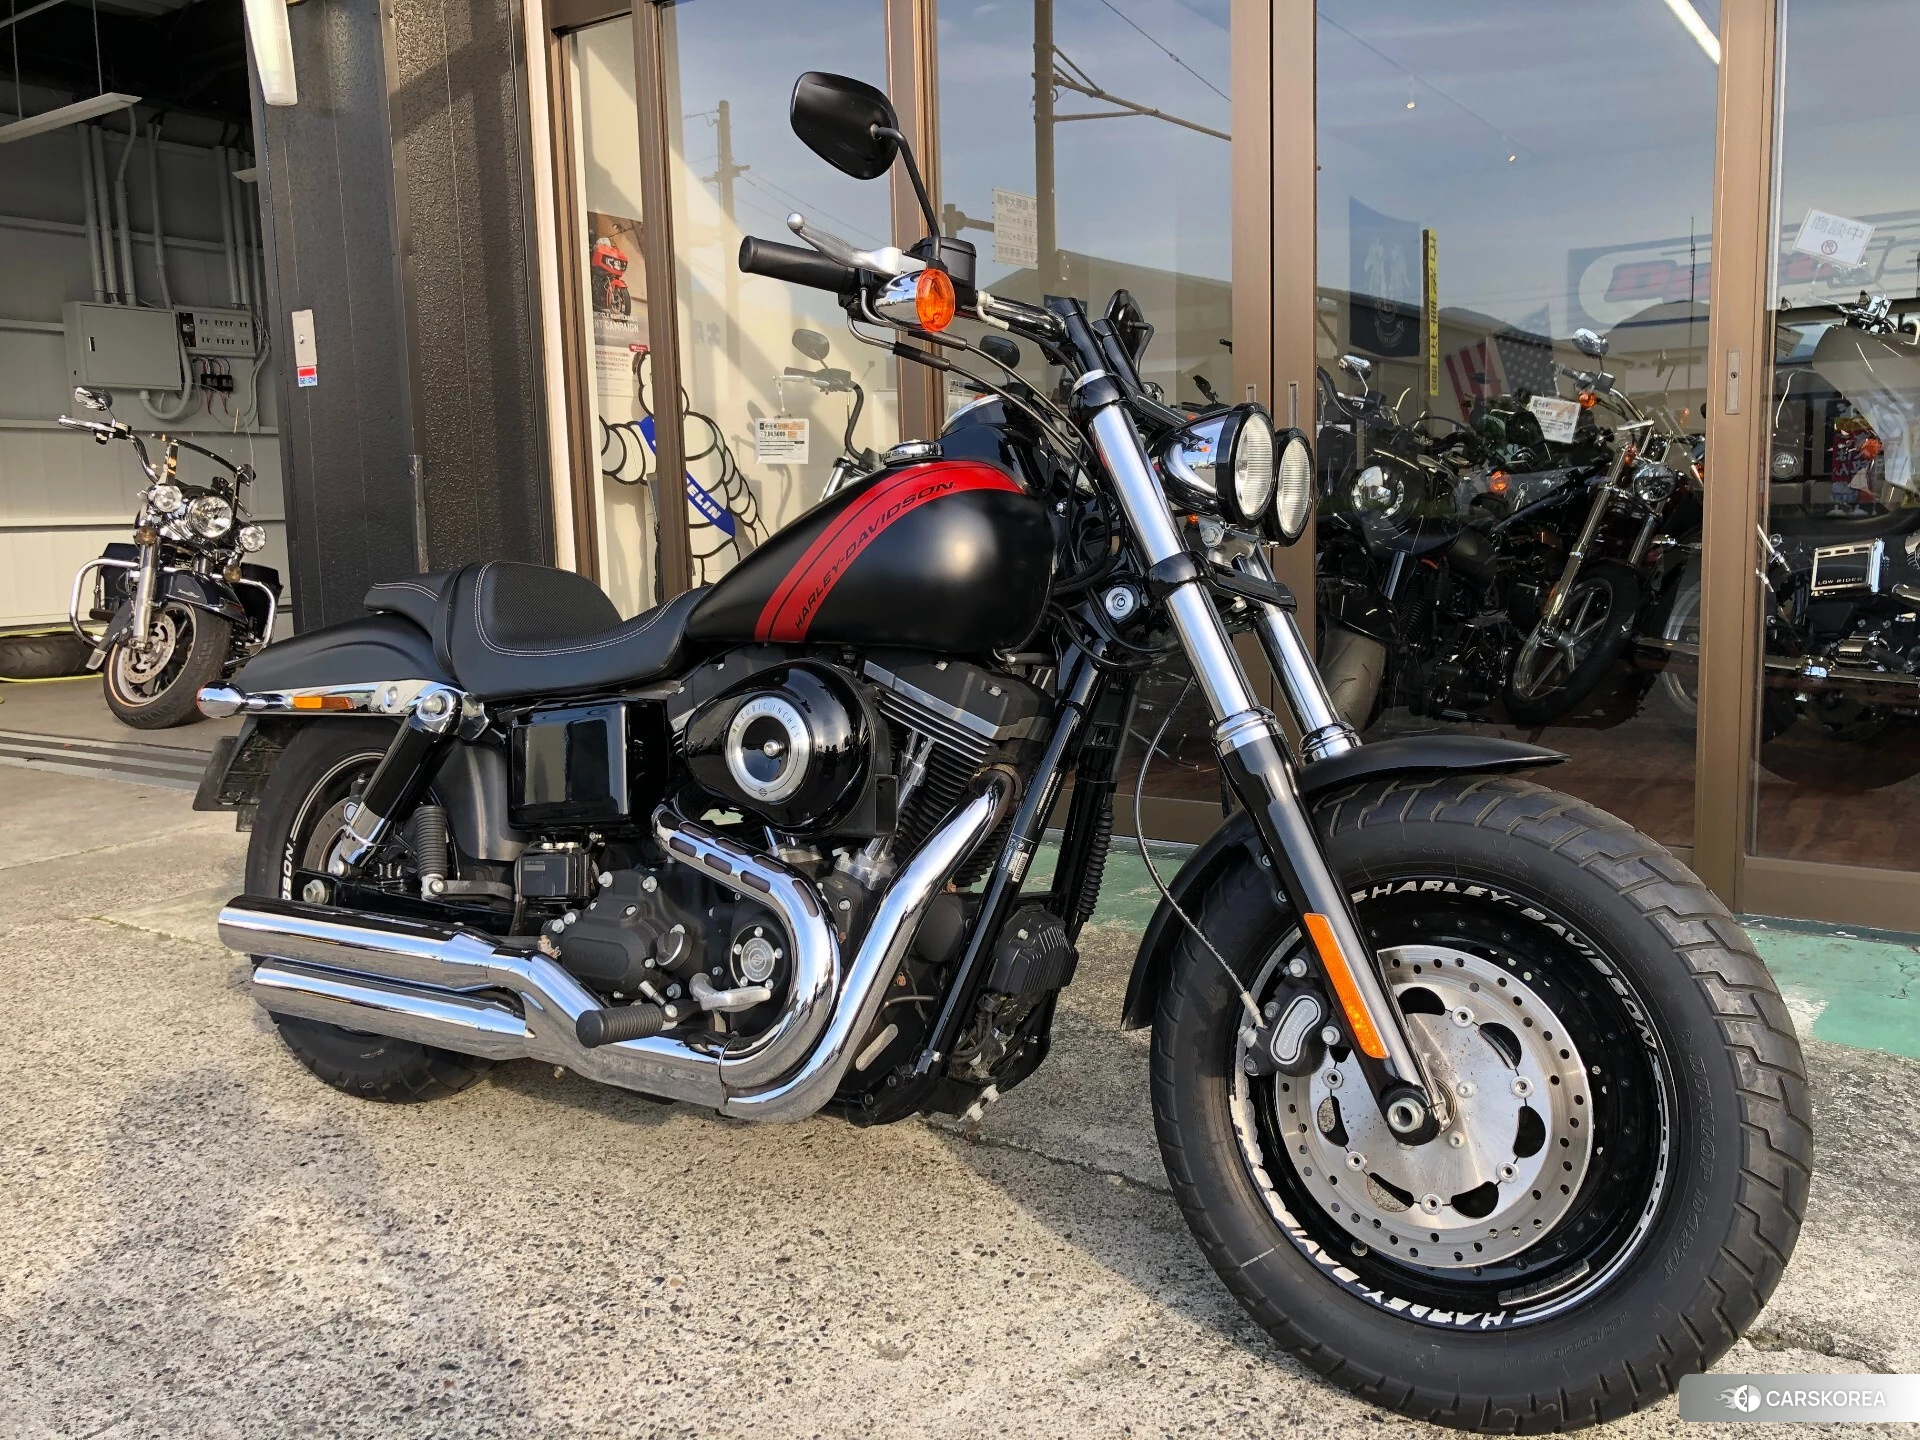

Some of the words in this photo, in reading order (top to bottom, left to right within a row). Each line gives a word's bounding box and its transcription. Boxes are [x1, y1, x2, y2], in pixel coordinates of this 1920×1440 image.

[604, 320, 639, 333] CAMPAIGN
[299, 376, 316, 385] SEOM
[686, 478, 722, 520] ELIN
[795, 481, 955, 632] HARLEY-DAVIDSON
[1818, 578, 1834, 586] LOW
[1836, 577, 1863, 585] RIDER
[740, 701, 767, 720] CUBIC
[772, 704, 801, 738] INCHES
[1371, 879, 1658, 1052] HARLEY-DAVIDSON
[1689, 1054, 1717, 1184] DUNLOP
